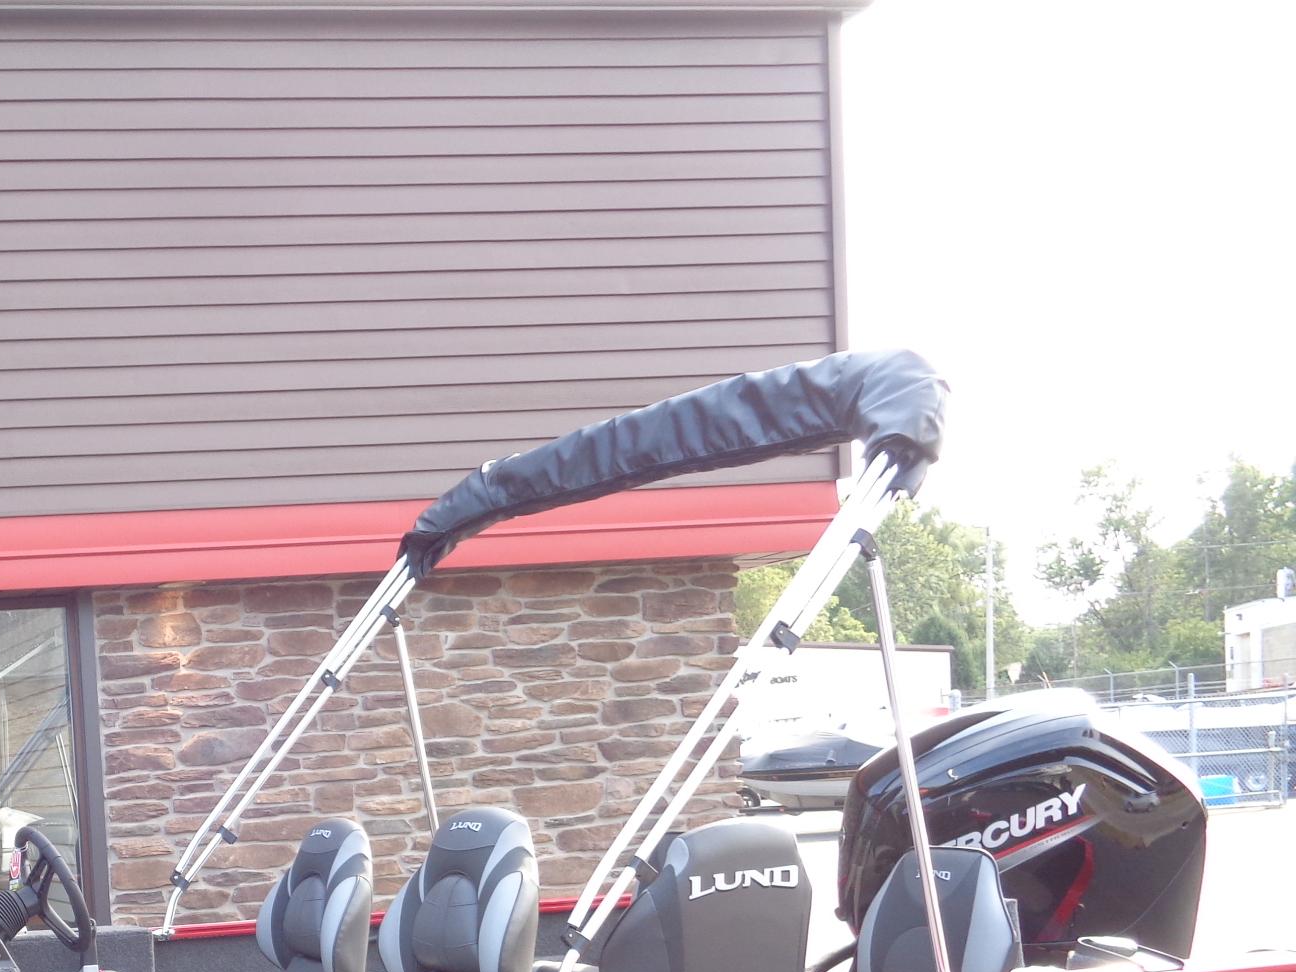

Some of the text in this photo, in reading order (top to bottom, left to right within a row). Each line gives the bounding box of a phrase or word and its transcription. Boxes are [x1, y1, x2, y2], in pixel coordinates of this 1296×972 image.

[450, 821, 482, 832] LUND
[939, 784, 1086, 849] RCURY
[689, 865, 799, 901] LUND
[915, 869, 951, 881] LND
